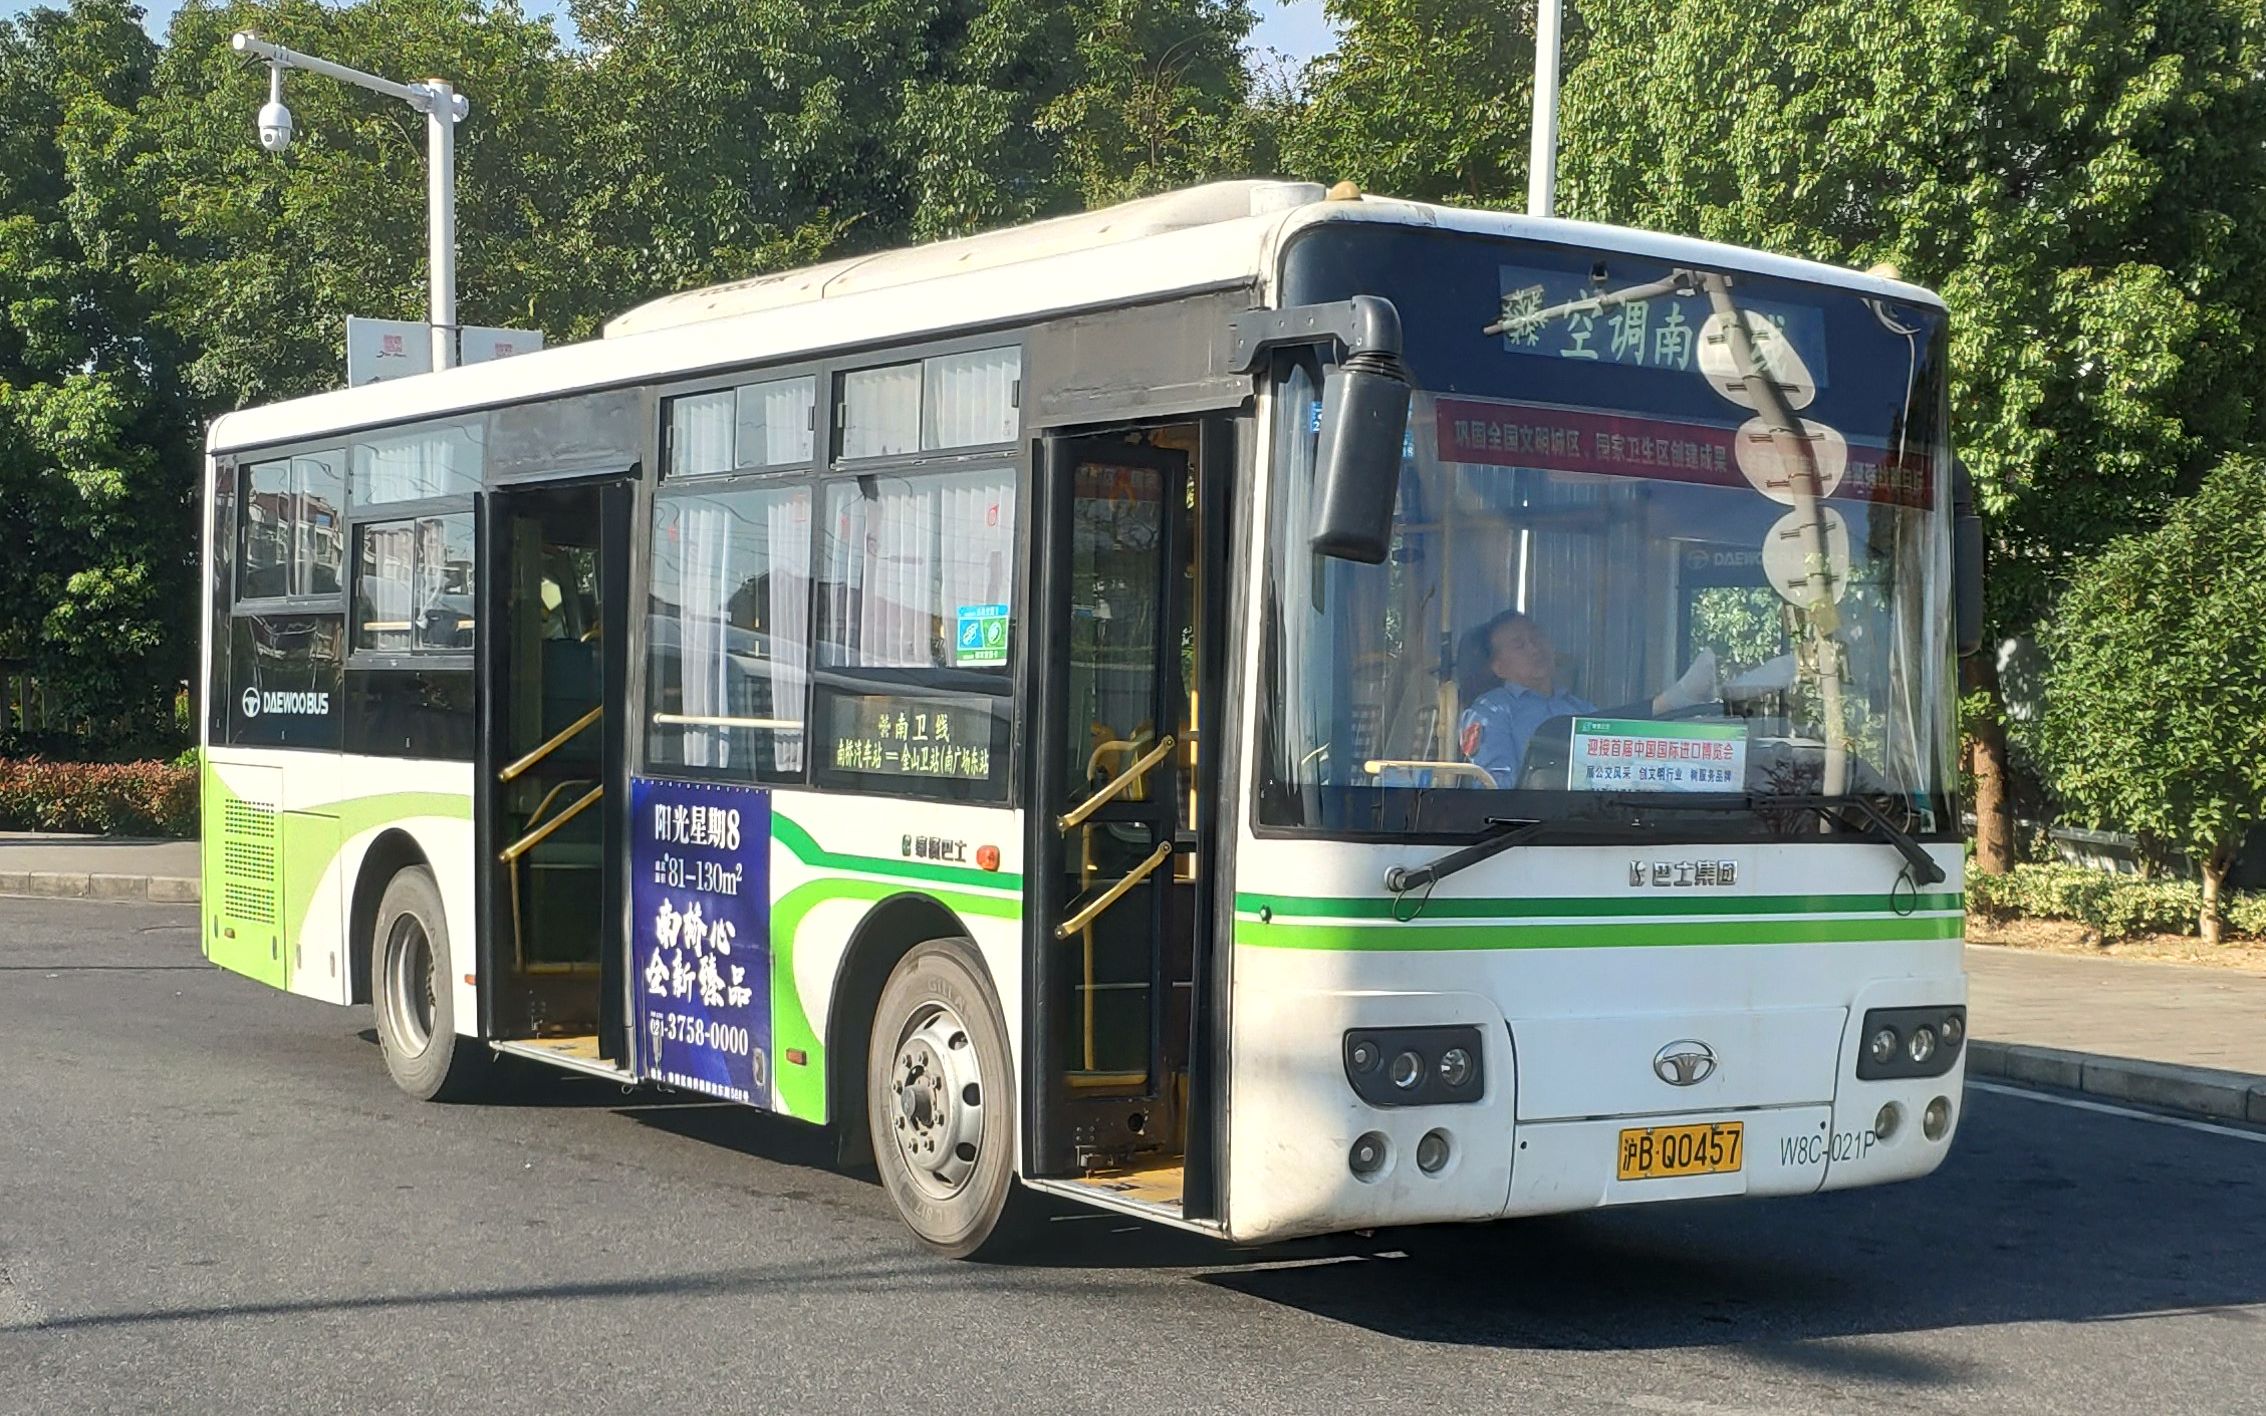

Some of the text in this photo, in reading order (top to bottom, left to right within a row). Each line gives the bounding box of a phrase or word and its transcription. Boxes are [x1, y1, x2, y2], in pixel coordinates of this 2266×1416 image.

[1587, 738, 1734, 761] 迎接首届中国国际进口博览会
[655, 803, 741, 850] 阳光星期8
[1779, 1129, 1876, 1167] W8C-021P
